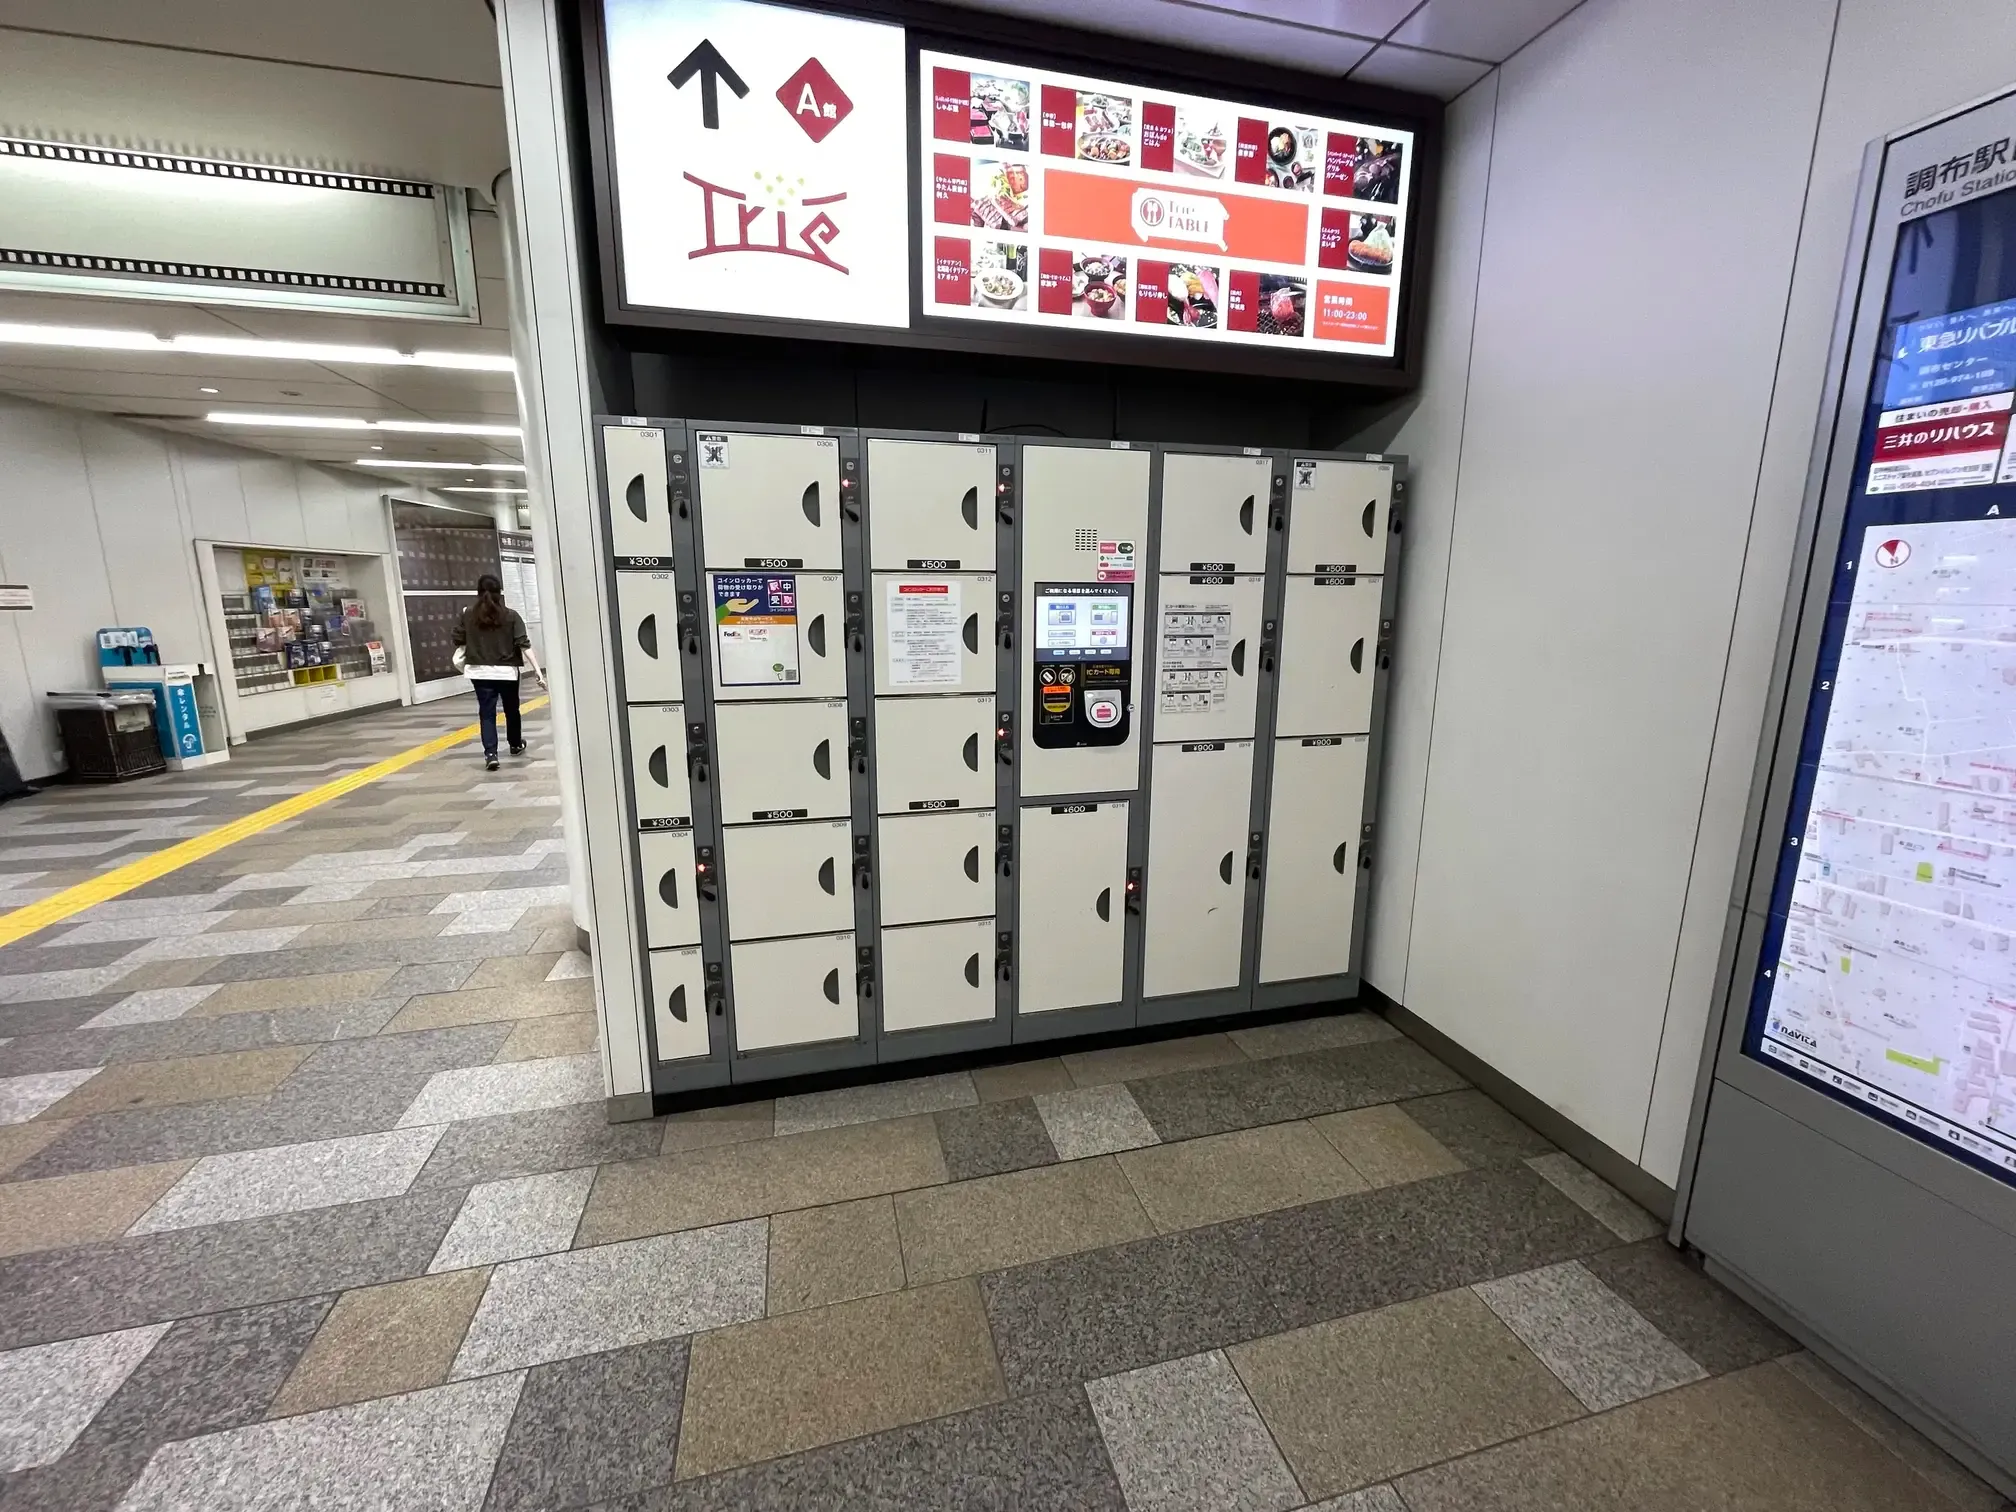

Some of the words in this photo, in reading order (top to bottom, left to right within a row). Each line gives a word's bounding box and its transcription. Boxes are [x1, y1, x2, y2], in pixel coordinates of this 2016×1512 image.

[1143, 138, 1160, 147] ごはん
[1904, 137, 2016, 200] 調布駅
[1900, 189, 1956, 217] Chofu
[1883, 421, 1995, 450] 三井のリハウス
[1986, 504, 2000, 516] A
[629, 557, 659, 566] ¥300
[760, 559, 788, 568] ¥500
[921, 560, 947, 569] ¥500
[1846, 560, 1853, 570] 1
[1202, 563, 1224, 571] ¥500
[1202, 576, 1224, 585] ¥600
[1325, 578, 1345, 586] ¥600
[1821, 681, 1830, 690] 2
[922, 800, 947, 808] ¥500
[766, 810, 794, 818] ¥500
[652, 818, 680, 826] ¥300
[1790, 836, 1798, 846] 3
[1764, 970, 1772, 978] 4
